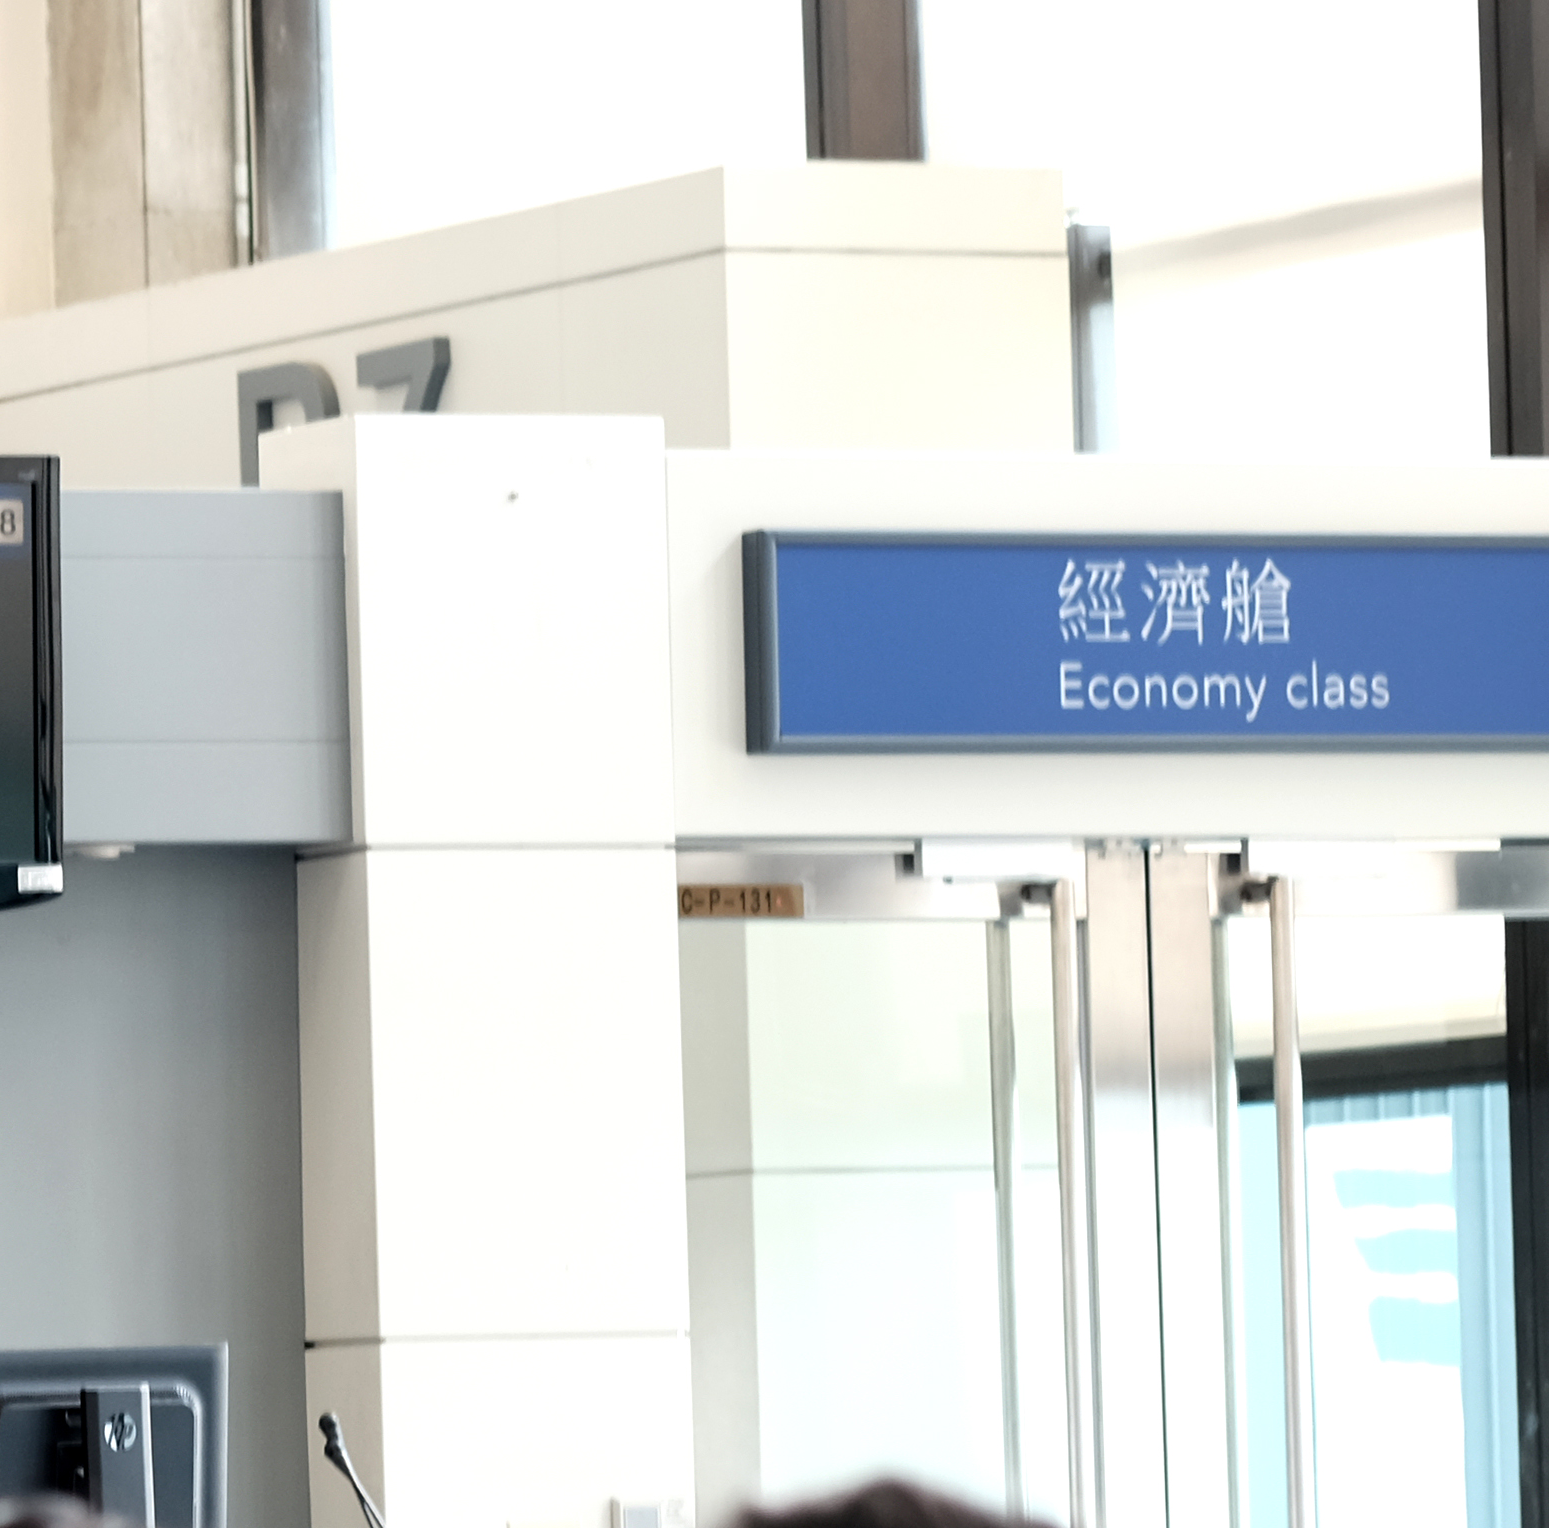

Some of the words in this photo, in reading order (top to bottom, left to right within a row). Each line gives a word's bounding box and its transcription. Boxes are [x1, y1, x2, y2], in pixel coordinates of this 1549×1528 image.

[1056, 557, 1292, 646] 經濟艙
[1060, 661, 1266, 721] Economy
[1286, 660, 1391, 708] class
